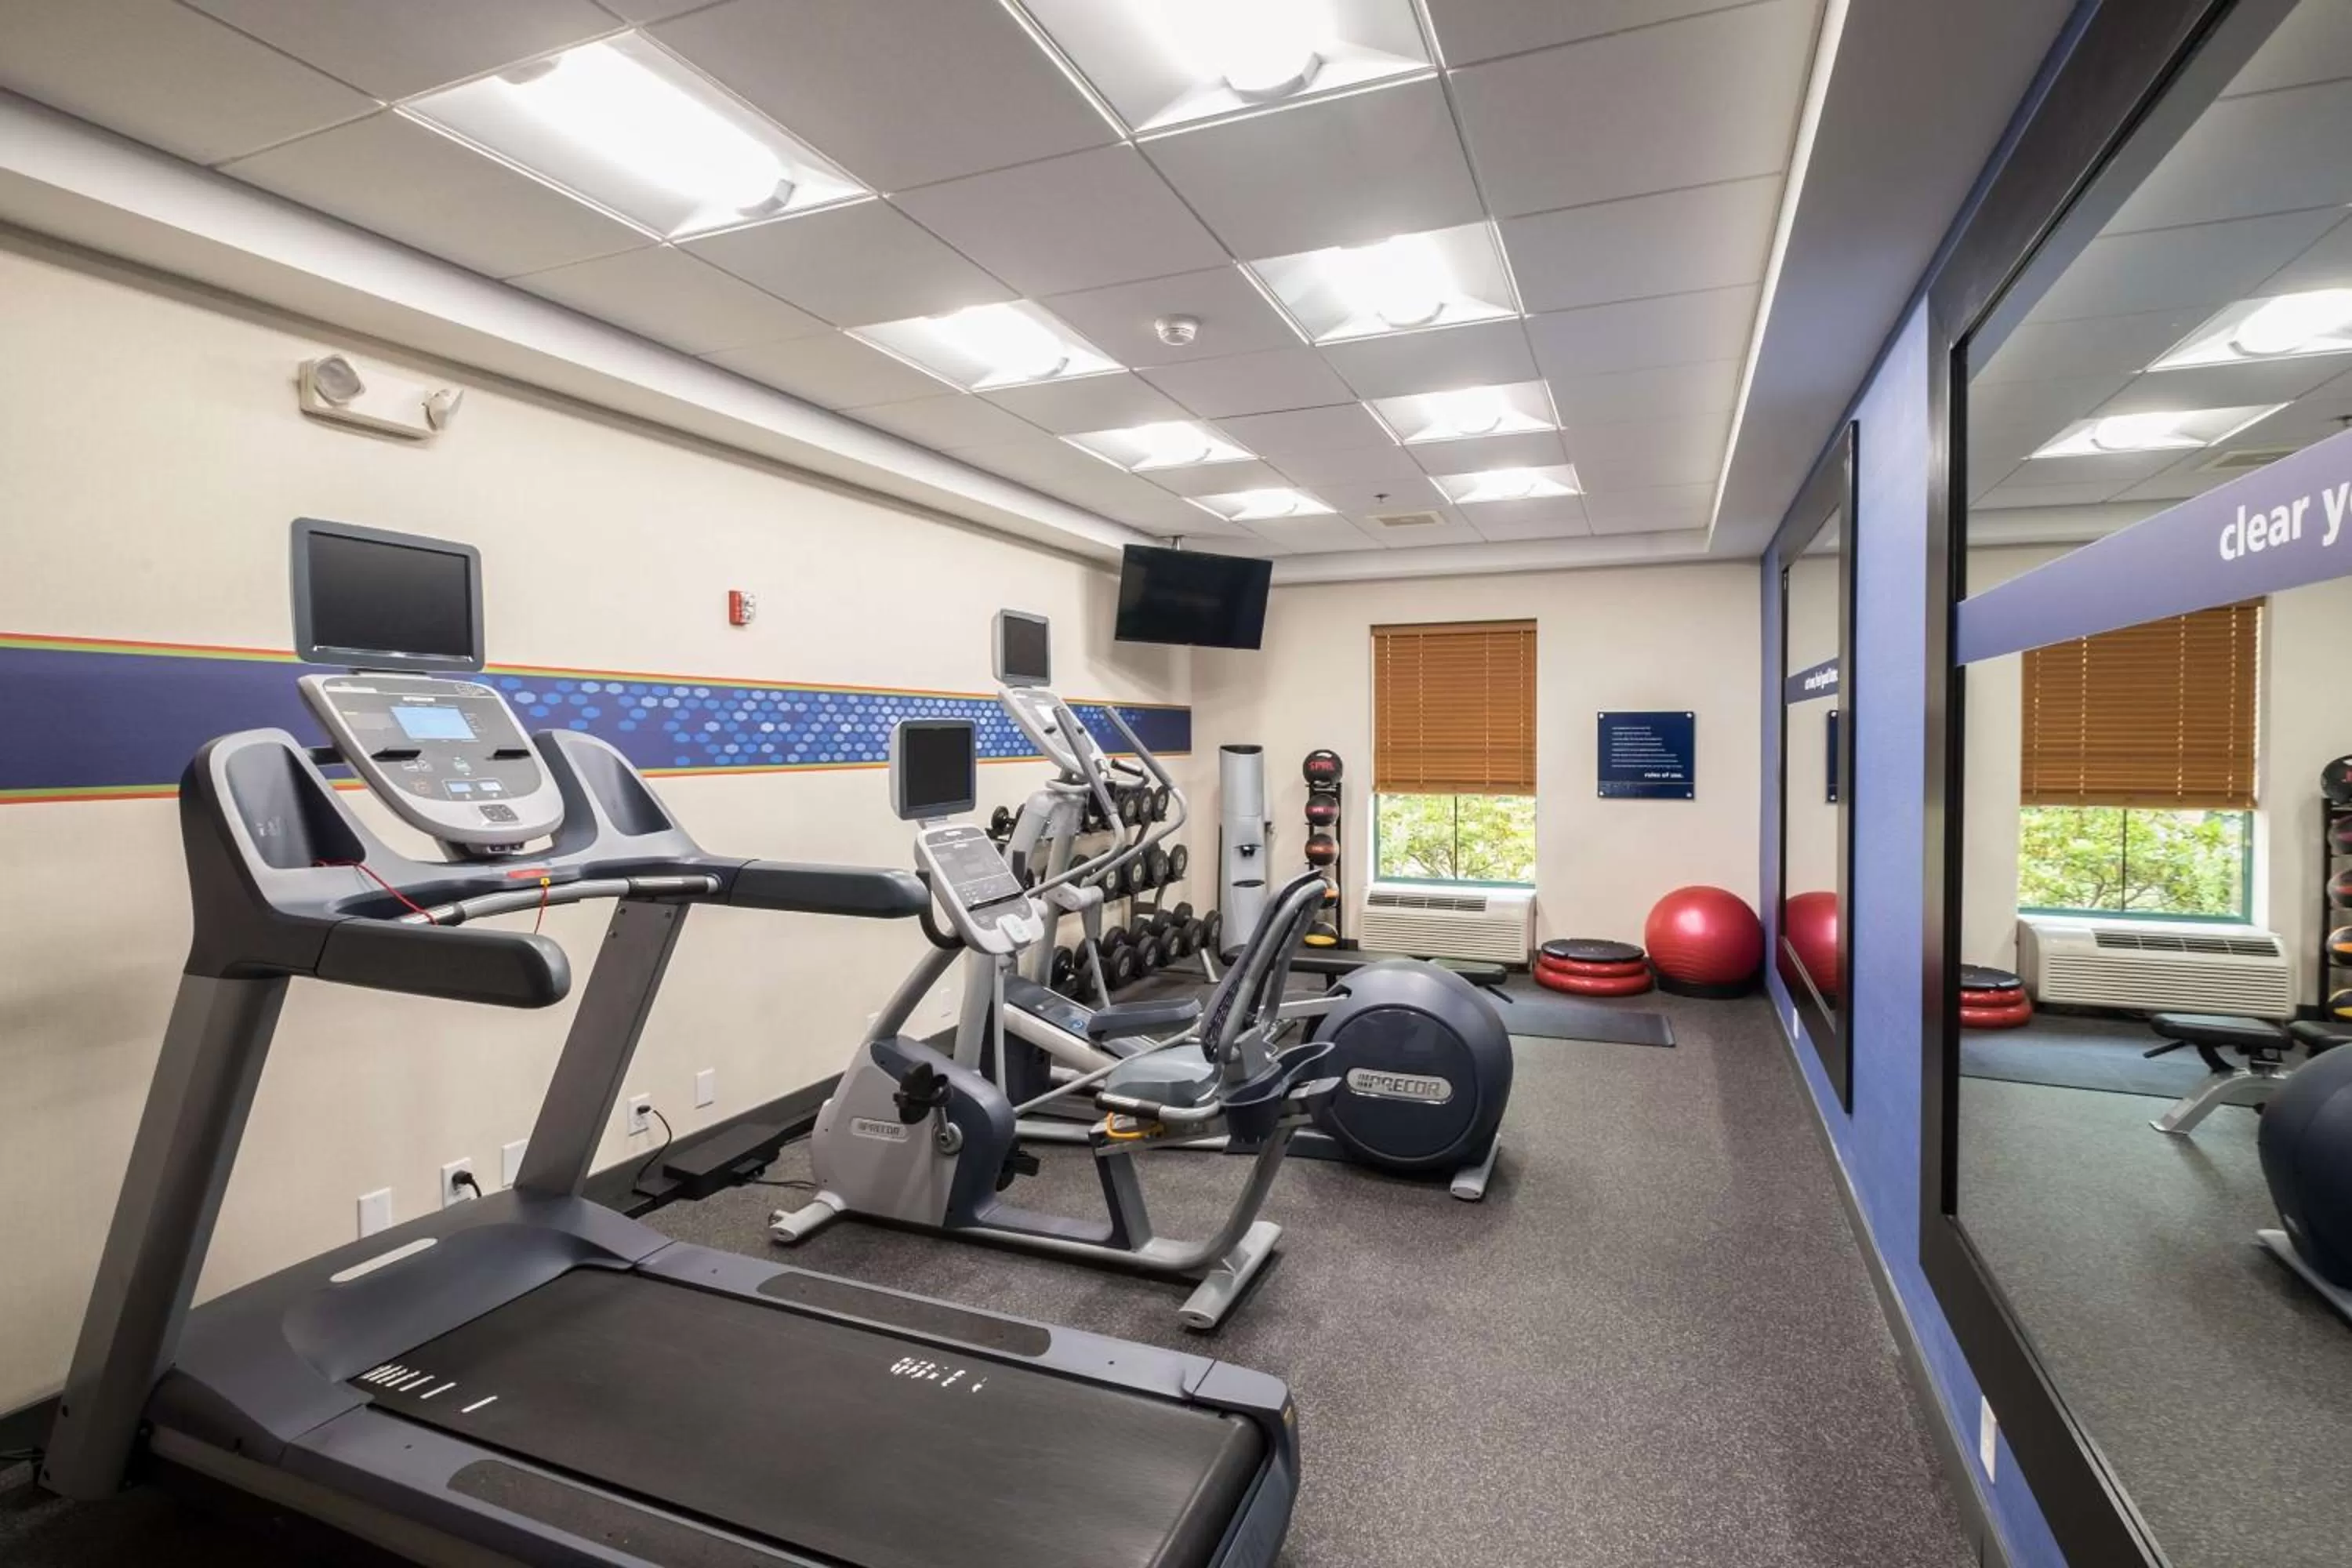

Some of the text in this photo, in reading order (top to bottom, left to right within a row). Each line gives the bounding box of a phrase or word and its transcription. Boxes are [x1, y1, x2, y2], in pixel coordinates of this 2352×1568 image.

[2220, 481, 2352, 561] clear y
[1370, 1074, 1441, 1096] PRECOR
